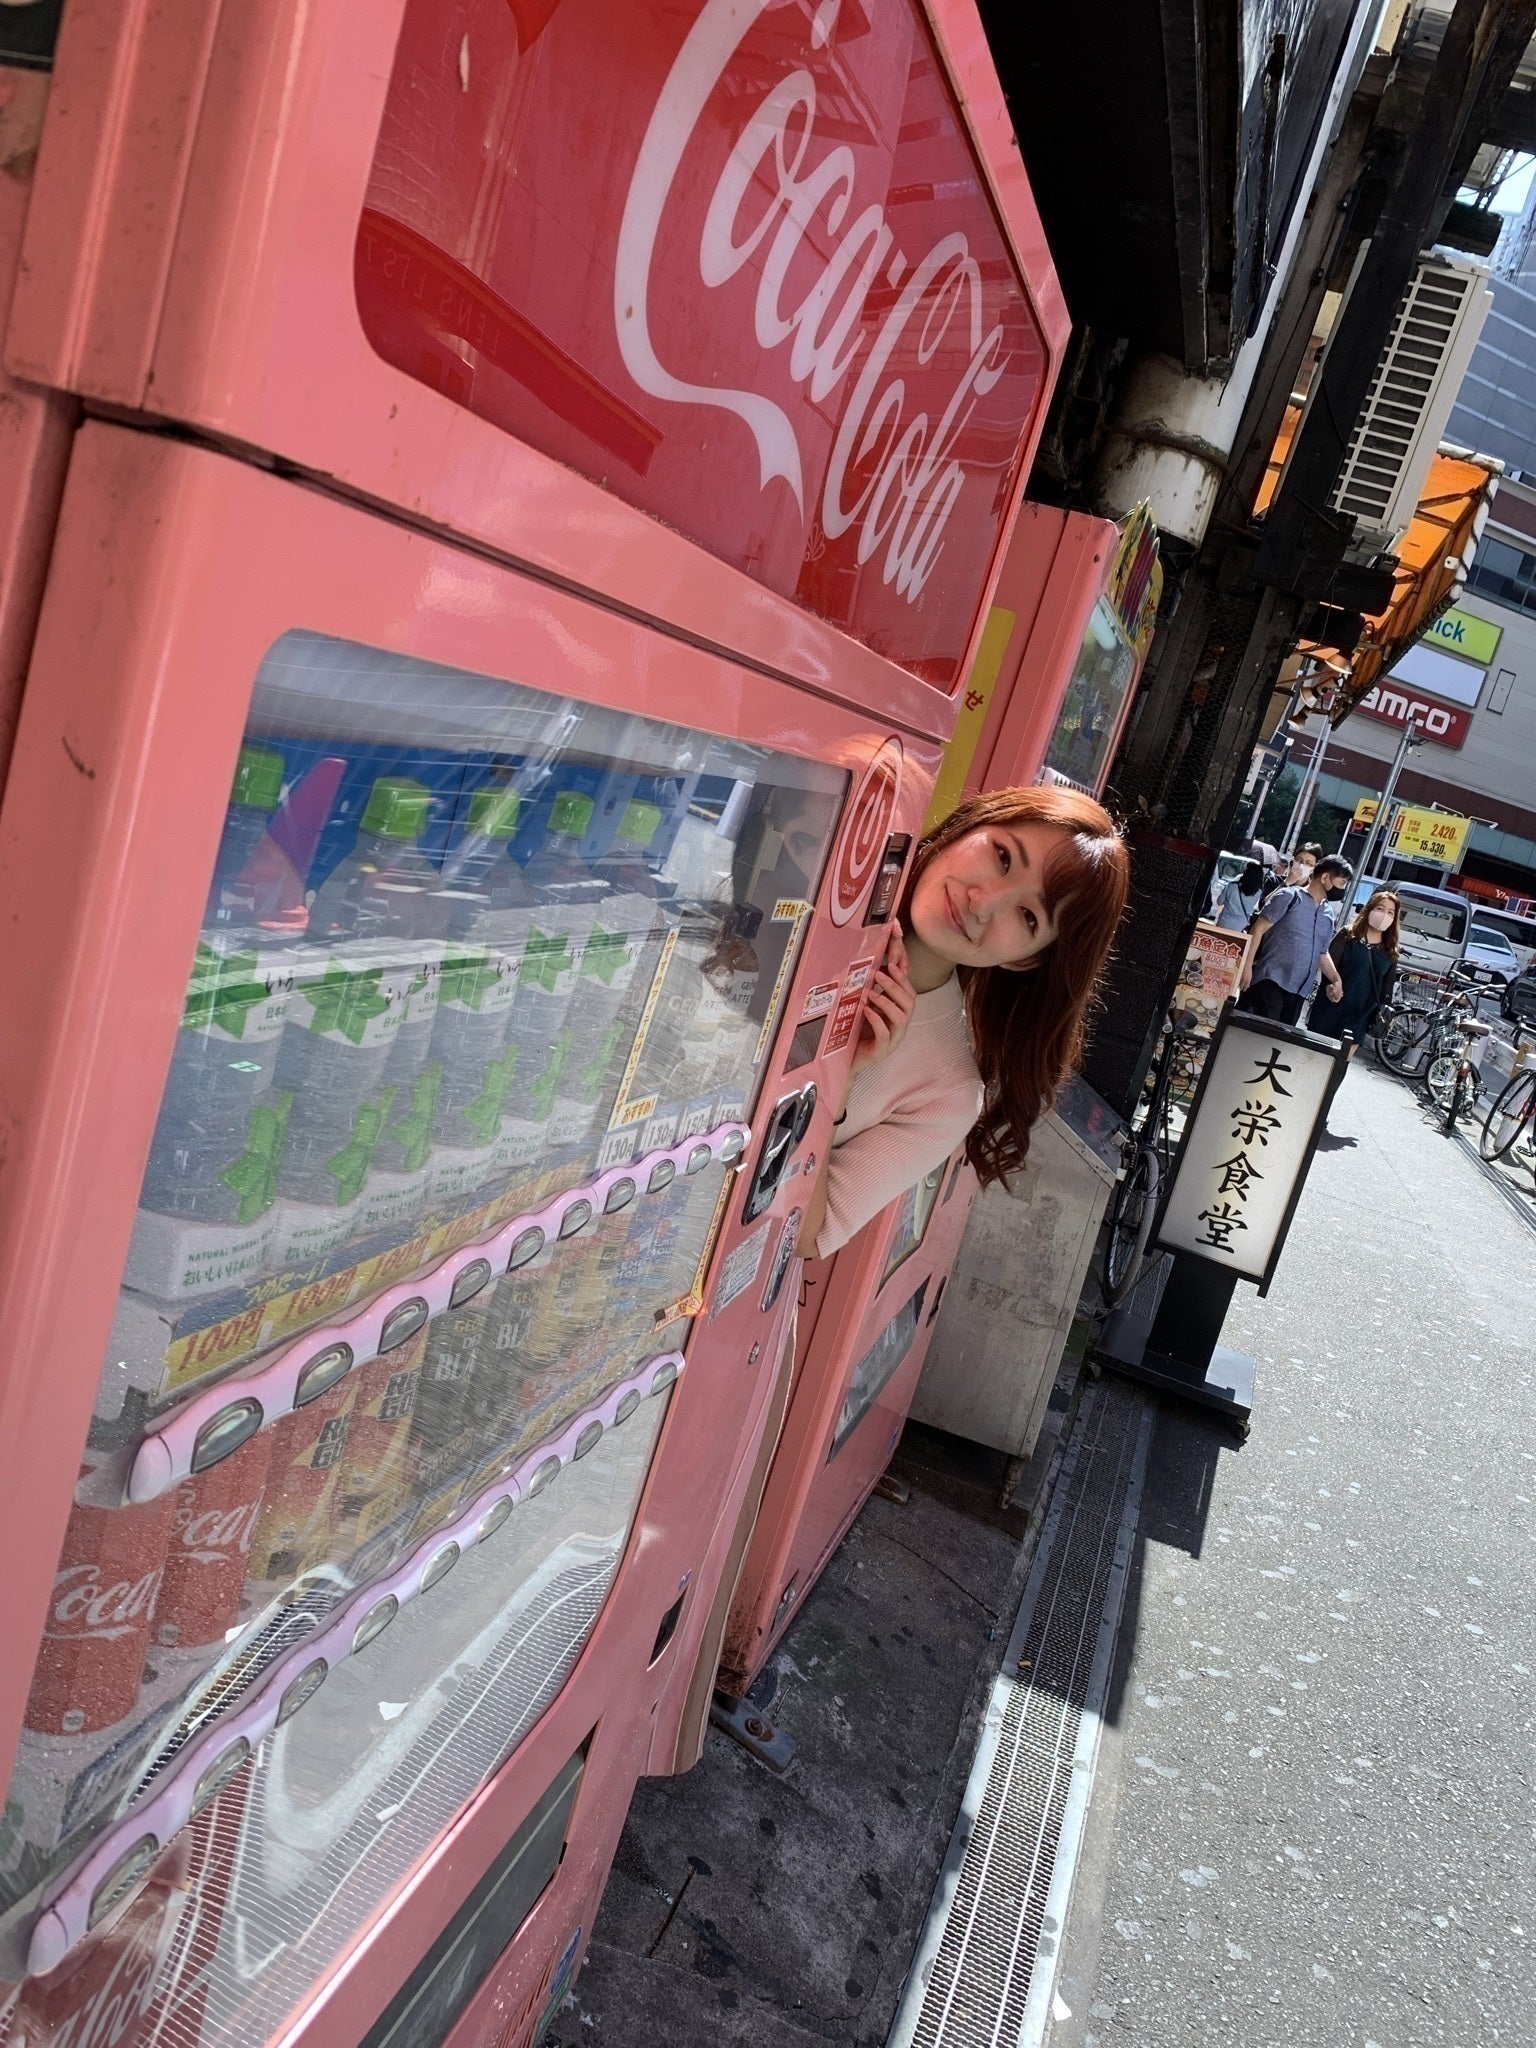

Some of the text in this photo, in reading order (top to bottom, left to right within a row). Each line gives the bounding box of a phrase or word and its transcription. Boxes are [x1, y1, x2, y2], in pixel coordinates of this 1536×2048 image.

[614, 0, 1010, 604] Coca-Cola
[1428, 619, 1467, 644] ick
[965, 690, 985, 712] せ
[1359, 686, 1451, 735] amco
[1195, 1047, 1293, 1254] 大栄食堂
[179, 1303, 267, 1371] 100円
